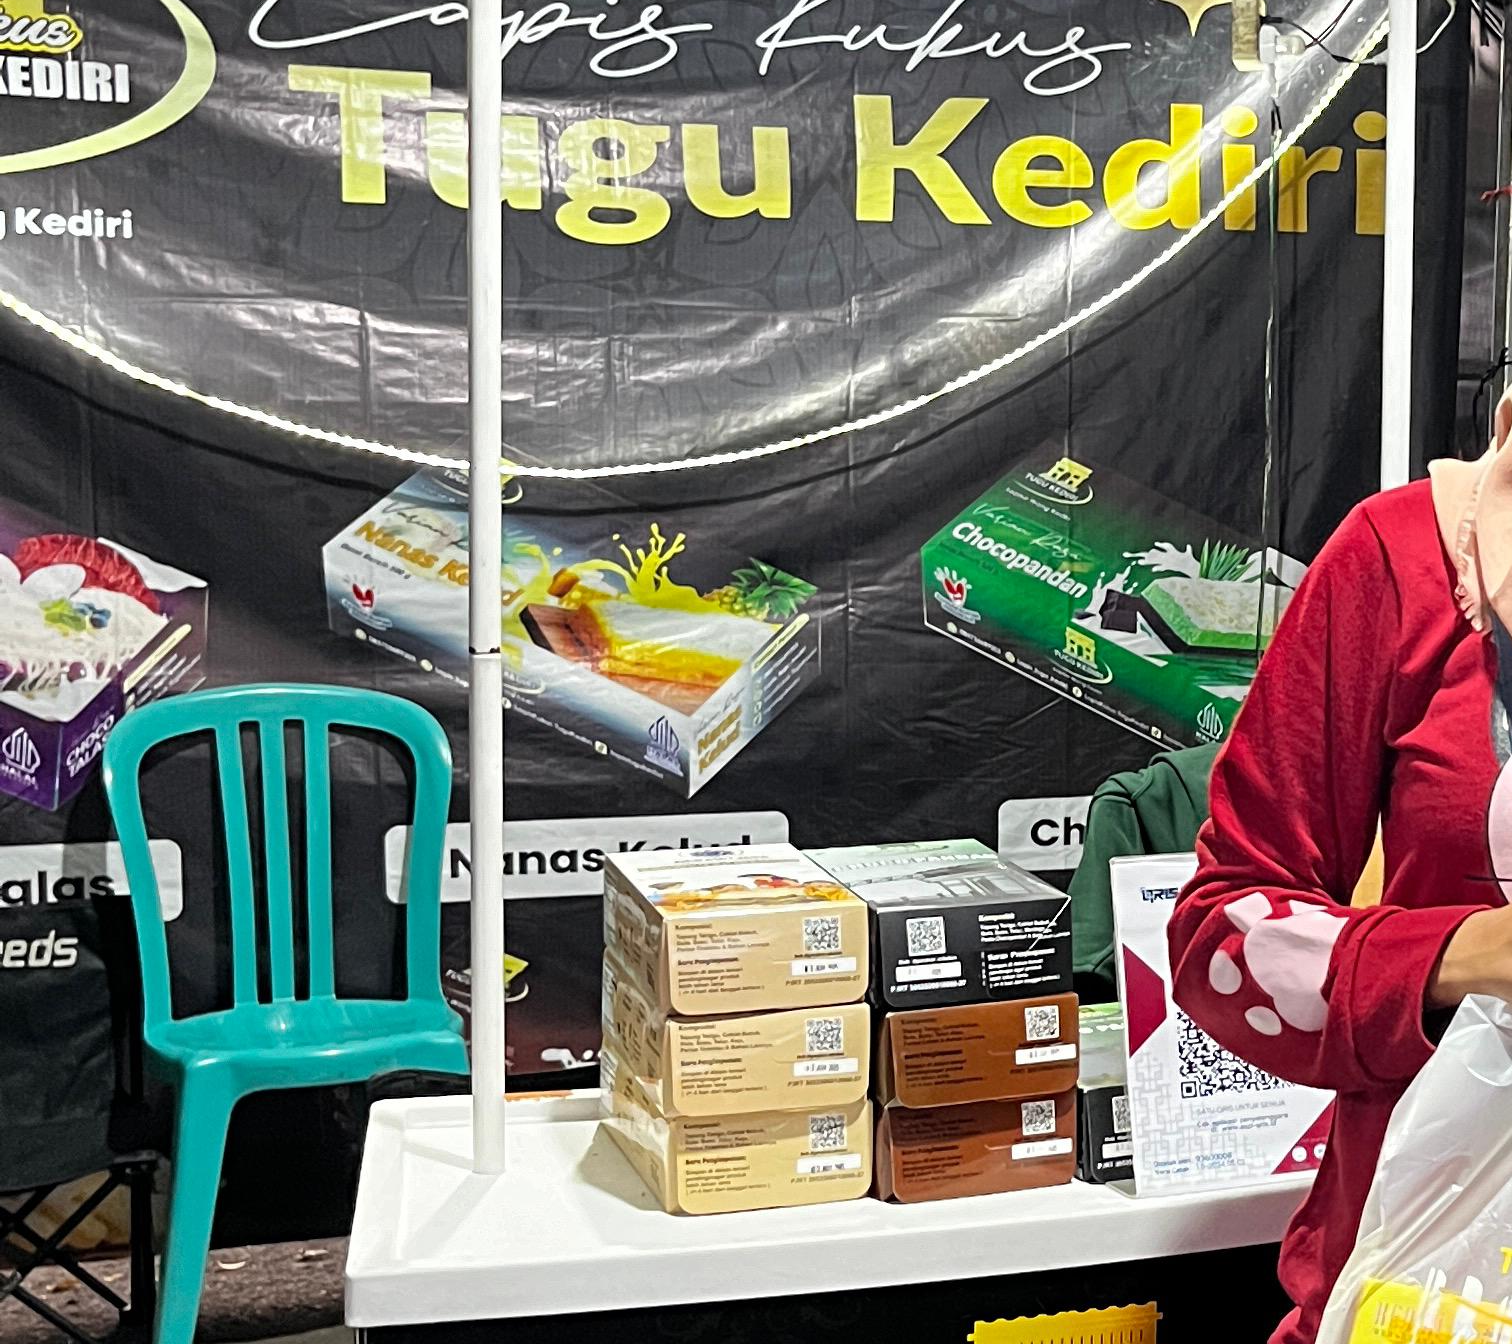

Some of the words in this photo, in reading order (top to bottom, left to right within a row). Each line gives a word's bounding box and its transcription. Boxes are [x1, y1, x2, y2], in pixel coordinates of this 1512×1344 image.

[288, 63, 791, 245] Tugu
[854, 94, 1387, 235] Kediri
[15, 206, 133, 239] Kediri
[952, 521, 1089, 600] Chocopandan
